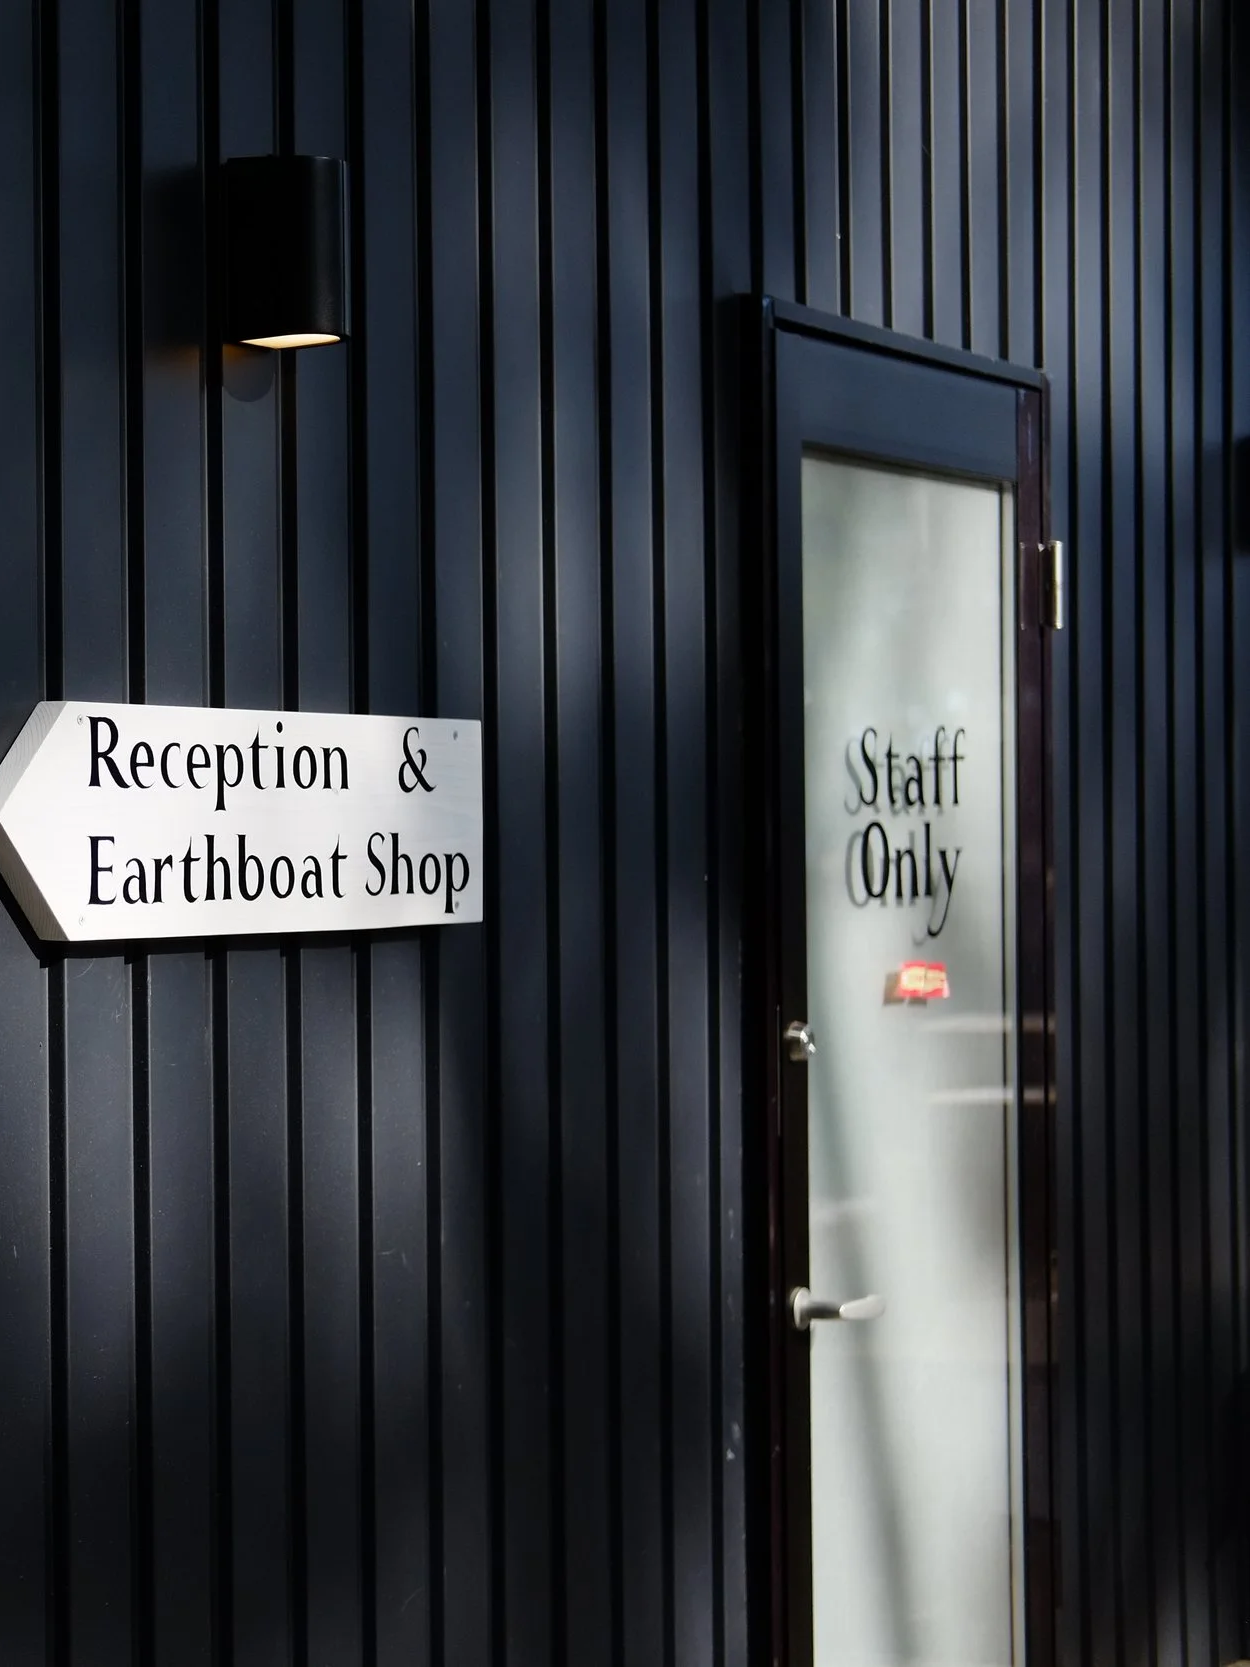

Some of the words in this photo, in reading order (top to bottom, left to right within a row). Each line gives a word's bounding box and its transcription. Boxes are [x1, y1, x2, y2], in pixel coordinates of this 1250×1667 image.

[86, 716, 350, 812] Reception
[398, 726, 437, 794] &
[859, 726, 966, 807] Staff
[86, 834, 349, 906] Earthboat
[364, 831, 471, 914] Shop
[861, 821, 963, 938] Only
